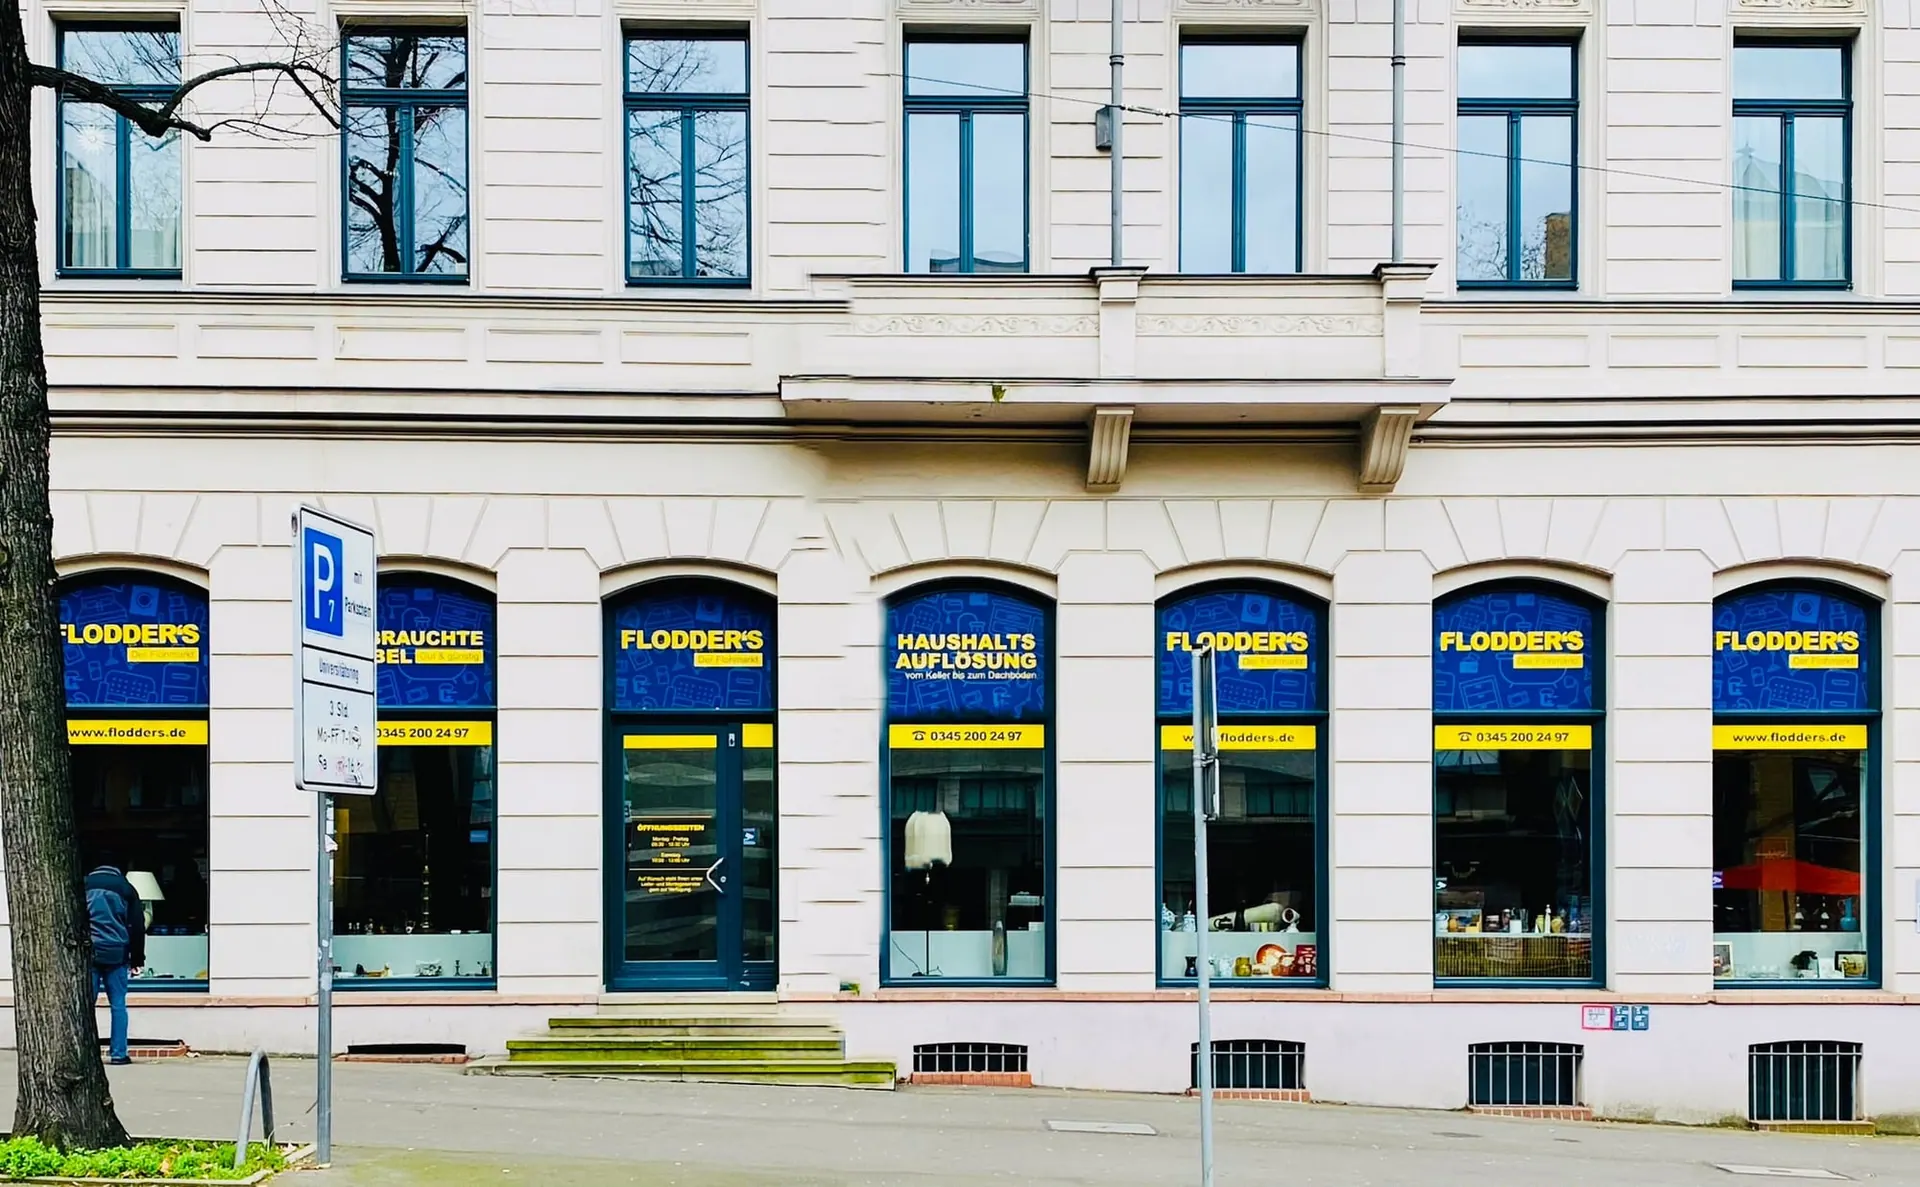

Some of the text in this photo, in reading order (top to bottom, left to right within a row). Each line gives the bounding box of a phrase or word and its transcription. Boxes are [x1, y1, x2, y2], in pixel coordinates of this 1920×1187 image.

[313, 542, 335, 619] P
[897, 633, 1036, 650] HAUSHALTS
[895, 650, 1037, 669] AUFLÖSUNG
[905, 671, 1037, 680] vom Keller bis zum Dachboden
[69, 727, 187, 738] www.flodders.de
[409, 728, 433, 738] 200
[435, 728, 451, 738] 24
[454, 728, 469, 738] 97
[930, 731, 1022, 741] 0345 200 24 97
[1476, 732, 1569, 742] 0345 200 24 97
[1733, 732, 1846, 743] www.flodders.de
